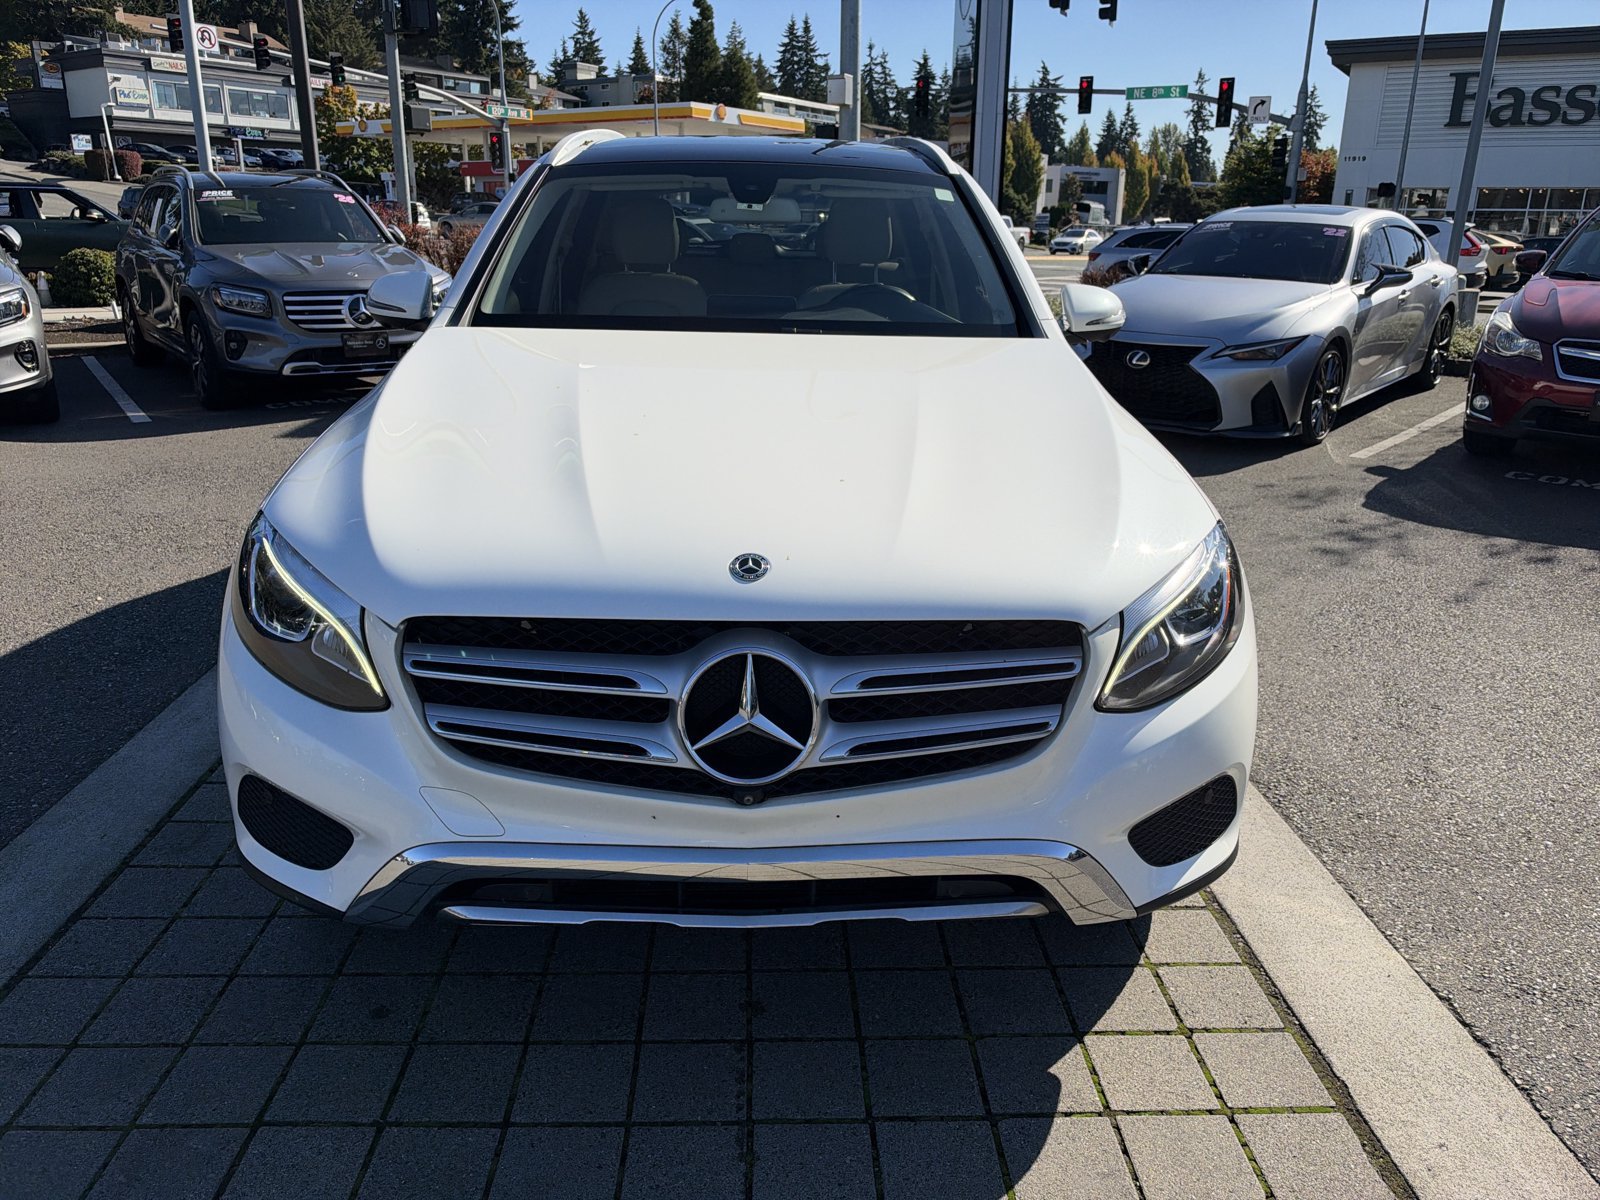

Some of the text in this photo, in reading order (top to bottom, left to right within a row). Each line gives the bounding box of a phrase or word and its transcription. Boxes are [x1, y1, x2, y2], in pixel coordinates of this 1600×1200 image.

[168, 61, 184, 70] NAILS
[1133, 86, 1180, 98] NE 8th St
[1444, 71, 1600, 127] Bass
[508, 108, 518, 118] Ave
[520, 109, 528, 119] NE
